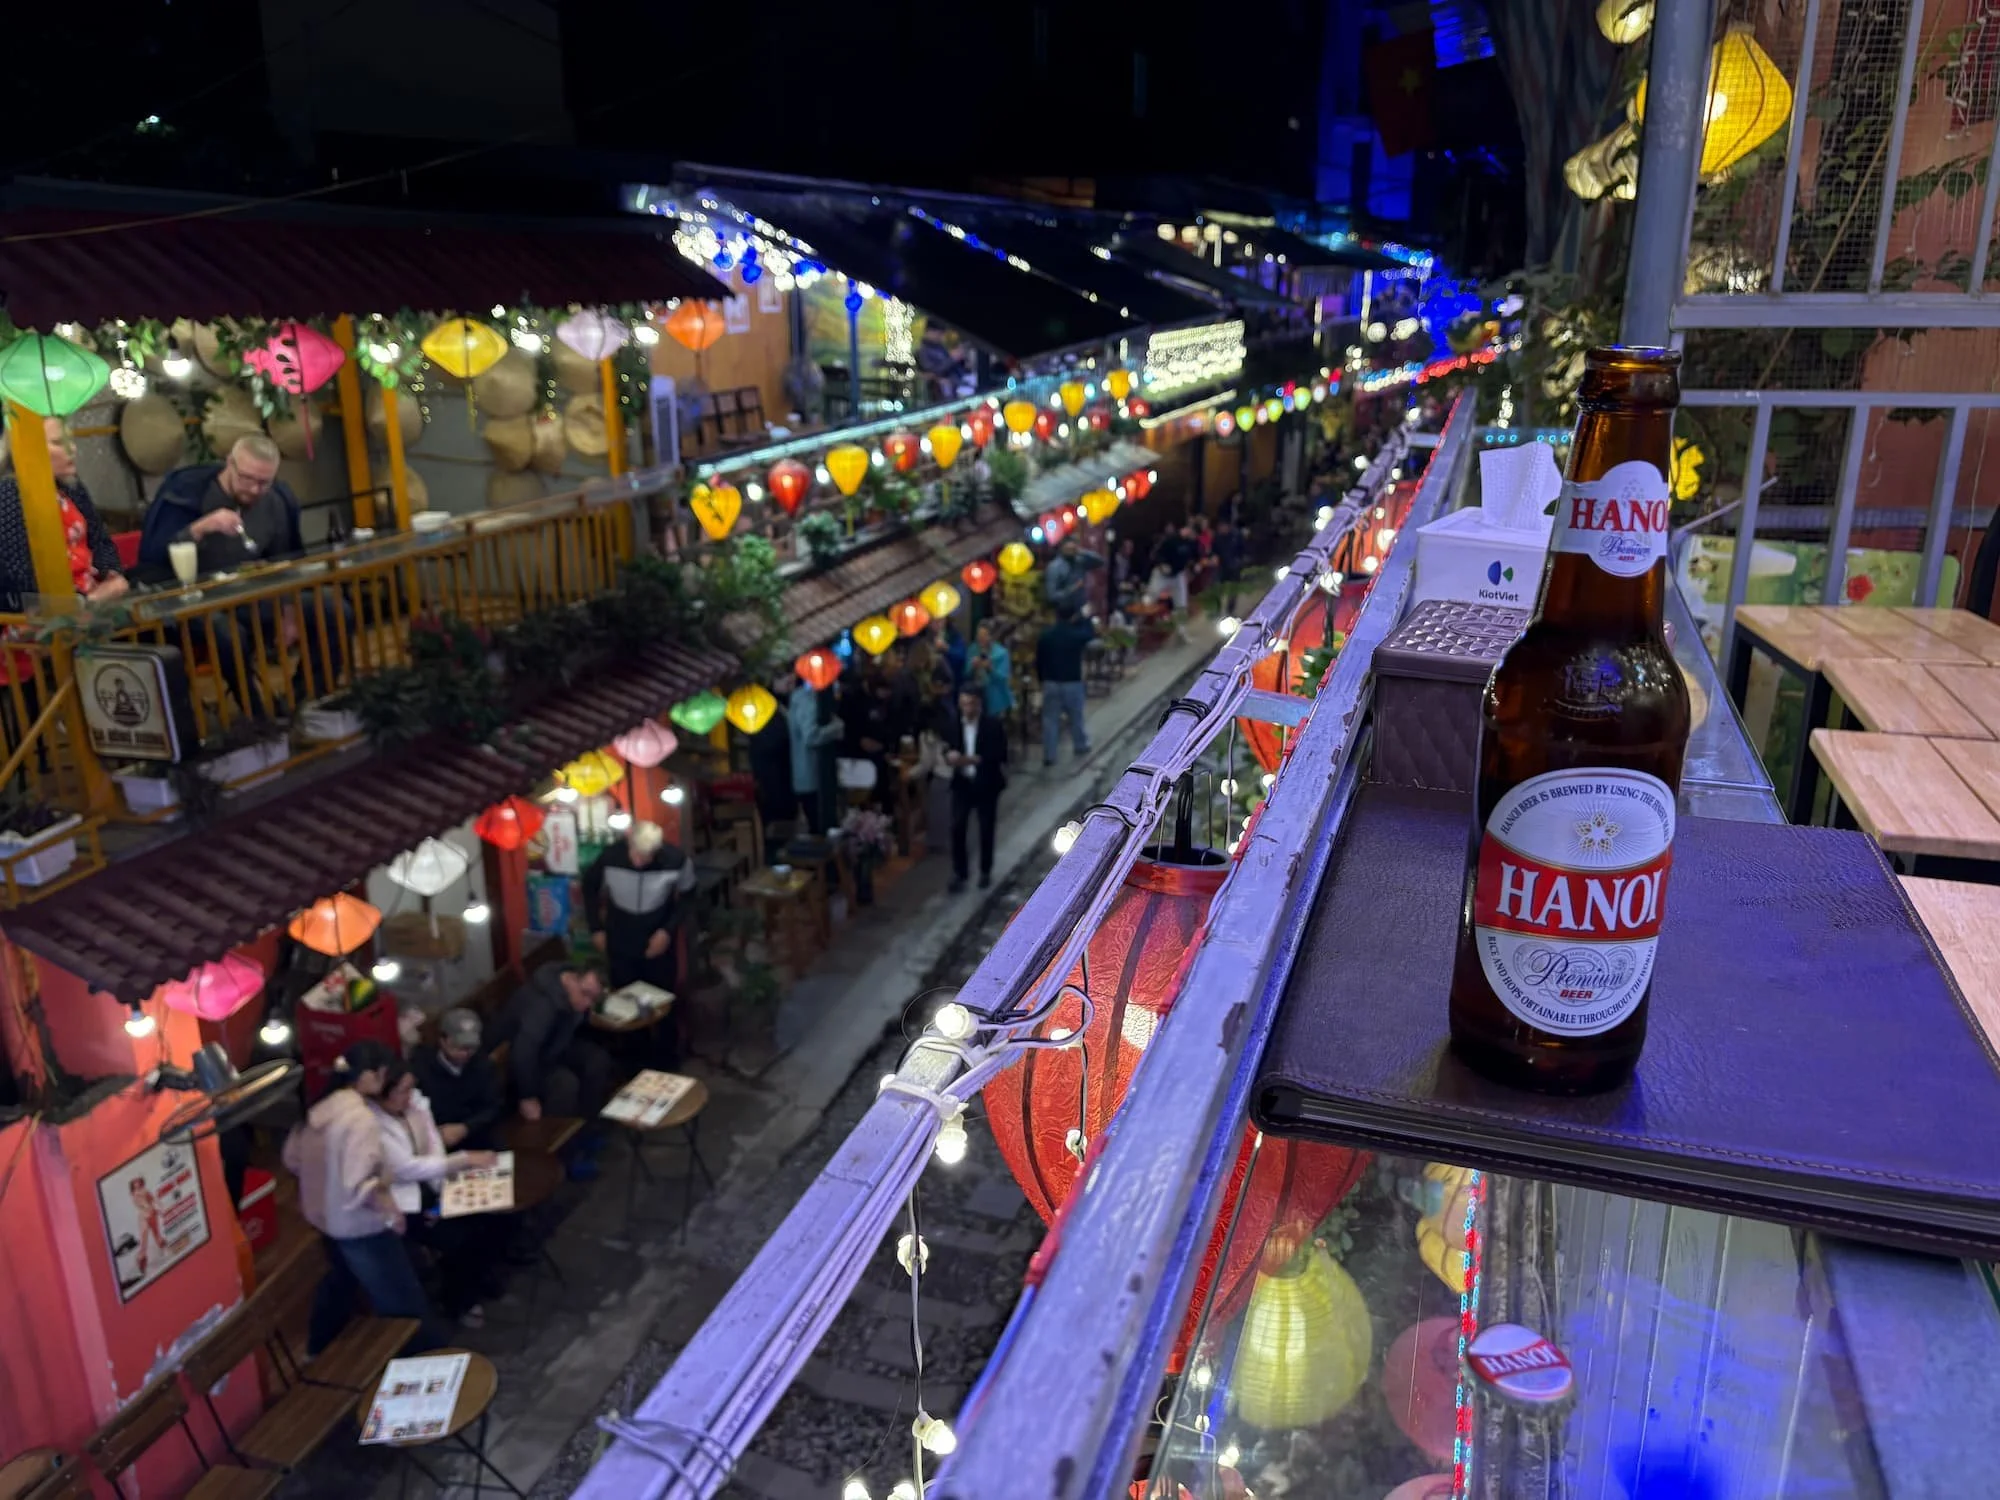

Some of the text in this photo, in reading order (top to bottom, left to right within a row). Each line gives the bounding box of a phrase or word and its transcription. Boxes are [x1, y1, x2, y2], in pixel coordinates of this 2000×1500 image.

[1478, 588, 1519, 603] KiotViet
[1500, 807, 1522, 836] HANOI
[1518, 795, 1541, 813] BEER
[1539, 790, 1550, 802] IS
[1549, 784, 1593, 798] BREWED
[1595, 784, 1608, 795] BY
[1610, 784, 1640, 799] USING
[1495, 861, 1664, 932] HANOI
[1487, 936, 1499, 957] RICE
[1493, 957, 1508, 977] AND
[1502, 976, 1524, 998] HOPS
[1520, 996, 1577, 1024] OBTAINABLE
[1577, 993, 1632, 1024] THROUGHOUT
[1631, 978, 1643, 994] THE
[1523, 947, 1625, 988] Premium
[1560, 989, 1594, 999] BEER
[1480, 1344, 1561, 1374] HANOI
